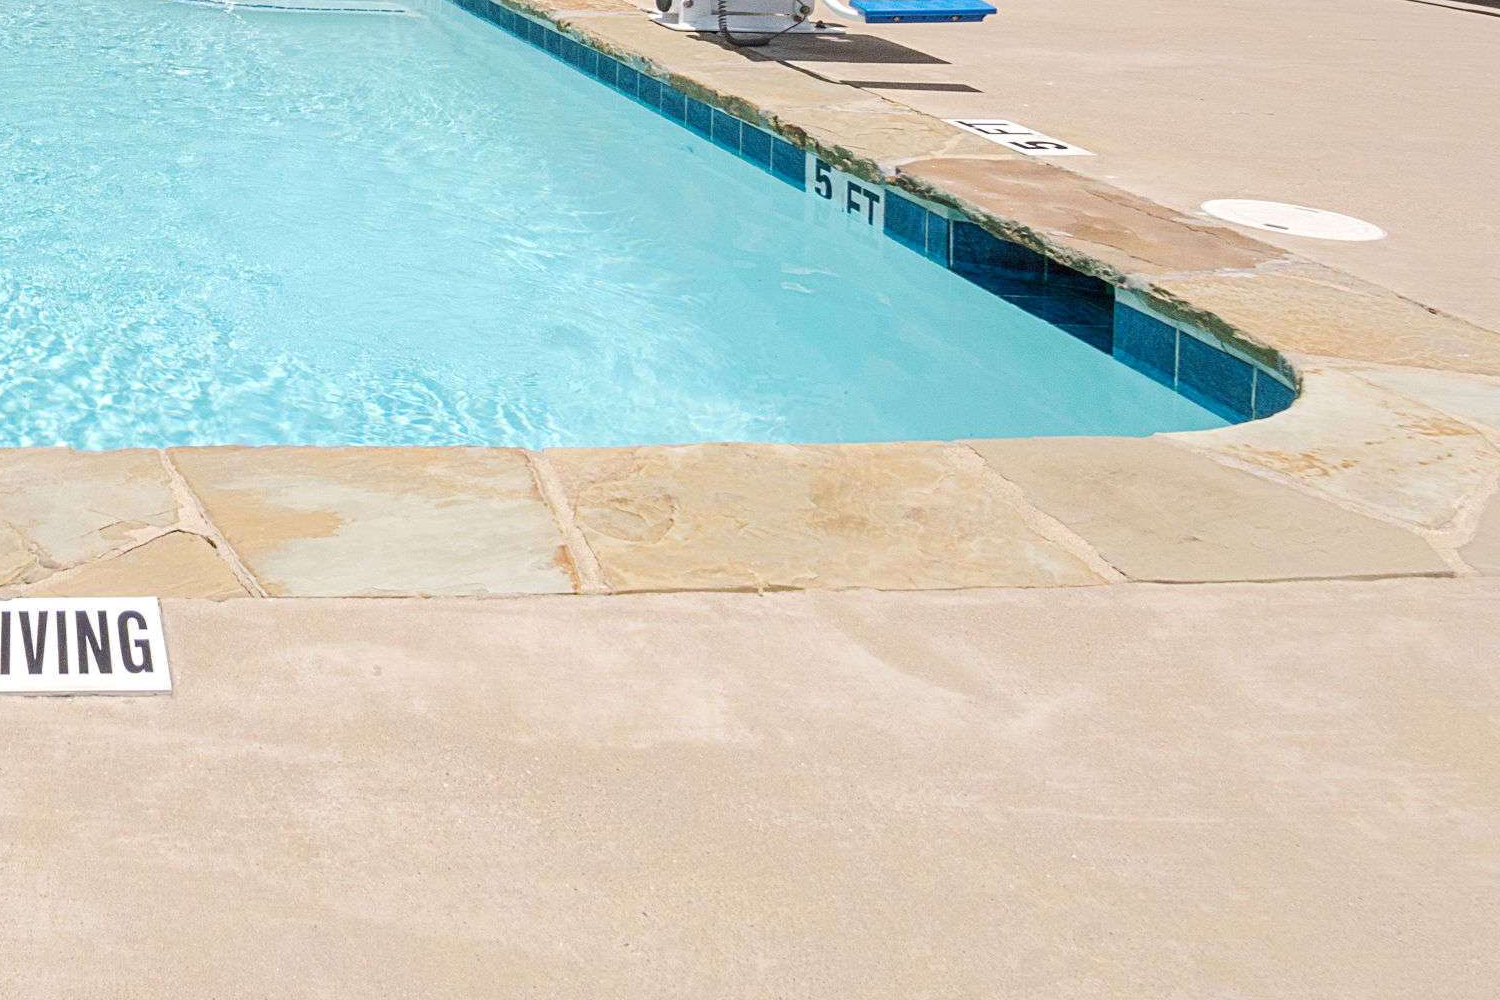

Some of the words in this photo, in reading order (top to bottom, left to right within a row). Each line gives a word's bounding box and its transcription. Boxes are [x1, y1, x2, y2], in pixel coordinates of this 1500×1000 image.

[955, 120, 1034, 136] FT
[1007, 141, 1069, 150] 5
[814, 158, 833, 200] 5
[847, 180, 880, 226] FT
